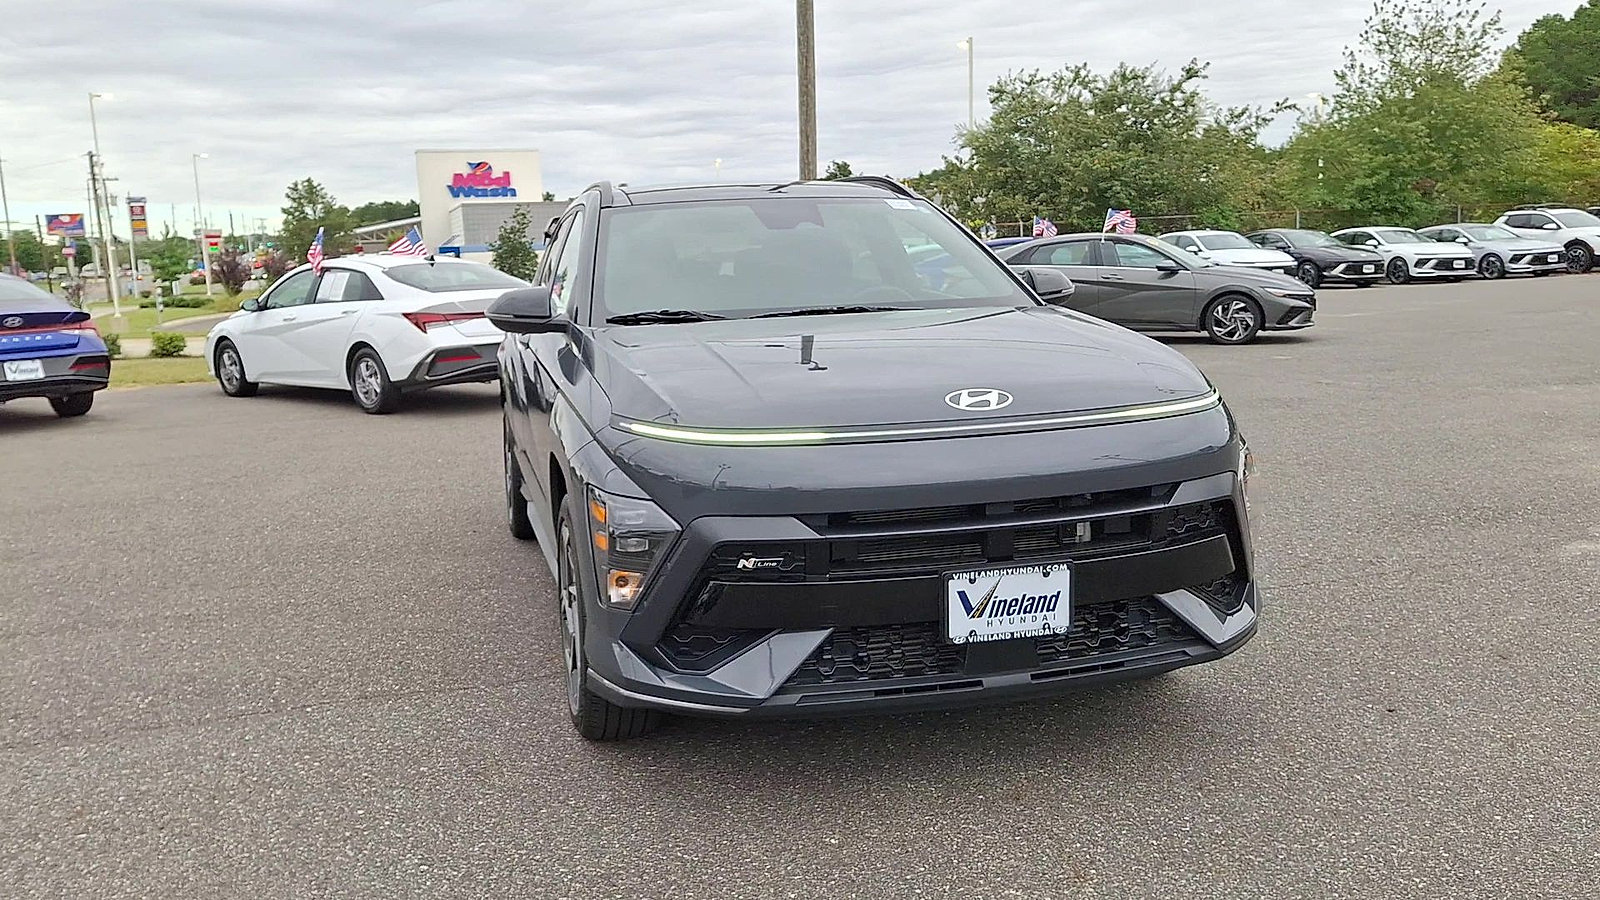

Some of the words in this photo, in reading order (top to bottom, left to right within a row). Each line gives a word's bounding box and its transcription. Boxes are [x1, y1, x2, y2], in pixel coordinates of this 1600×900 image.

[952, 563, 1068, 580] VINELANDHYUNDAI.COM
[956, 574, 1062, 619] Vineland
[987, 613, 1056, 628] HYUNDAI
[967, 631, 1012, 643] VINELAND
[1013, 628, 1054, 638] HYUNDAI
